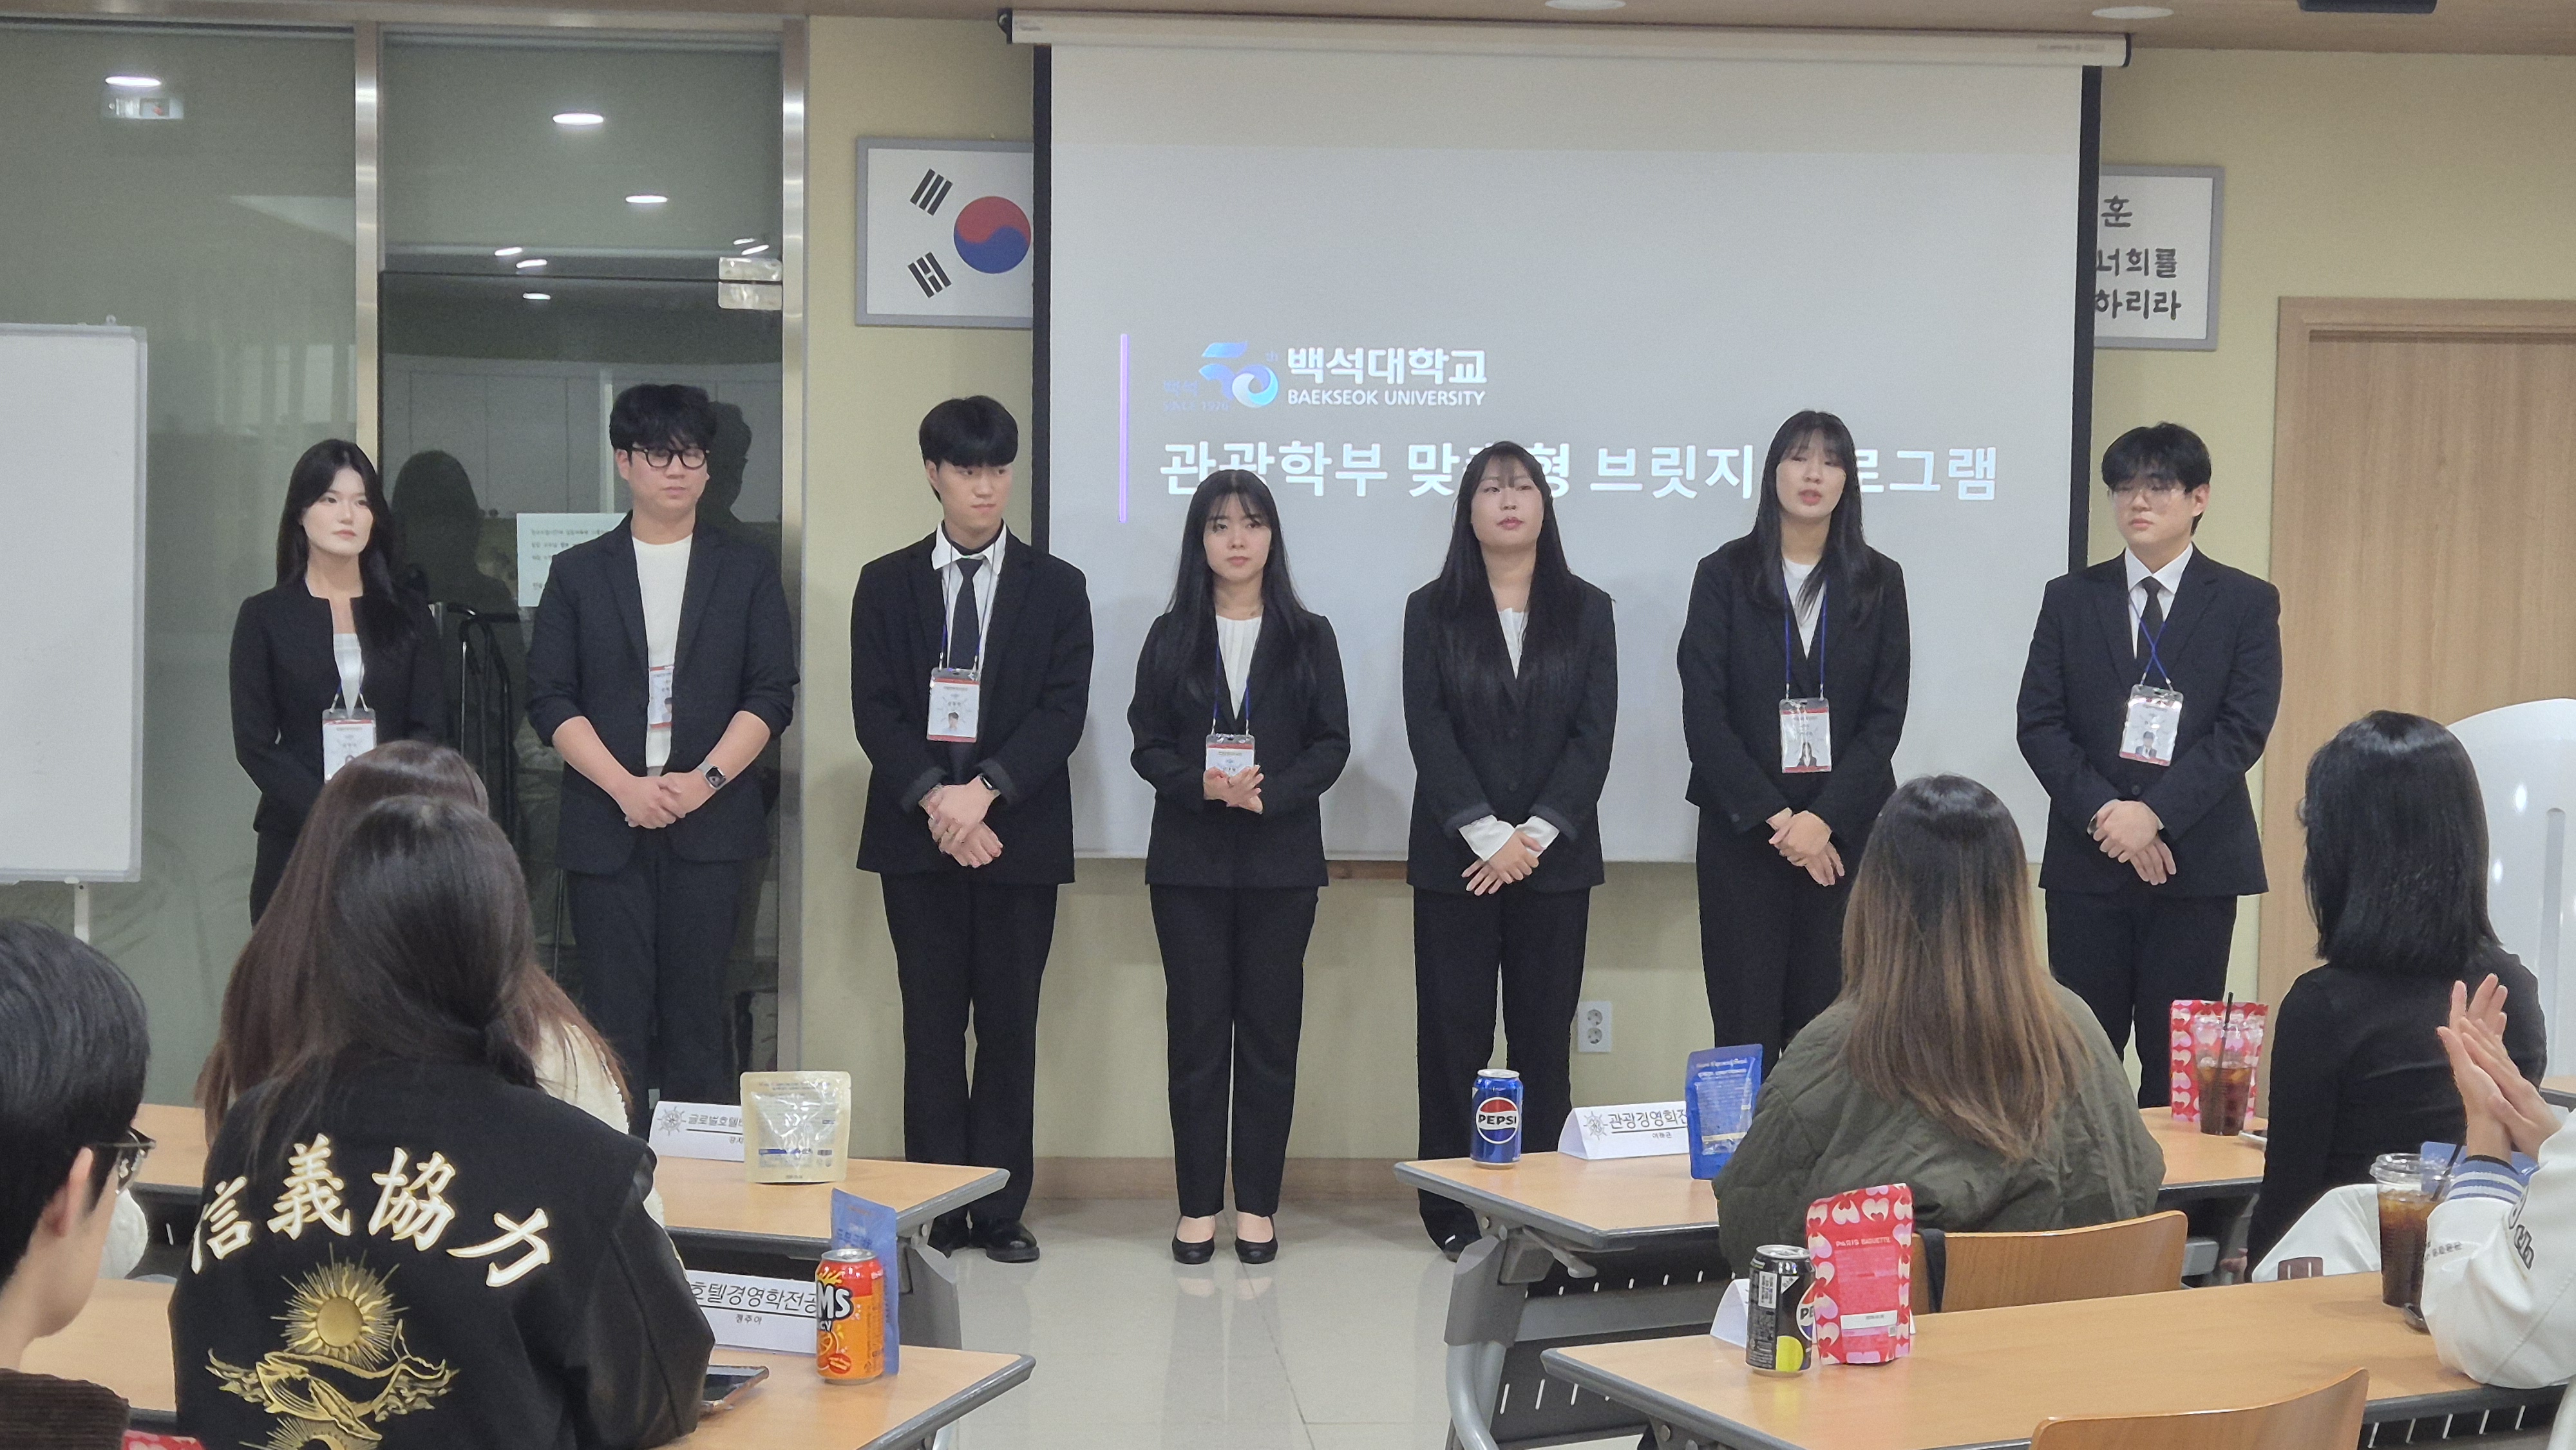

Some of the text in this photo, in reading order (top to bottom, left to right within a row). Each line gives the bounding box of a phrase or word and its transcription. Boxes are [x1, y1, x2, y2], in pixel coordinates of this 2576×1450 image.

[2101, 195, 2133, 227] 훈
[2097, 248, 2177, 278] 너희를
[2095, 288, 2182, 321] 하리라
[1288, 347, 1488, 384] 백석대학교
[1288, 390, 1486, 406] BAEKSEOK UNIVERSITY
[1160, 440, 1996, 500] 관광학부 맞형 브릿지 로그램
[1479, 1114, 1517, 1125] PEPSI
[191, 1133, 551, 1287] 信義協力
[1835, 1239, 1859, 1247] PARIS
